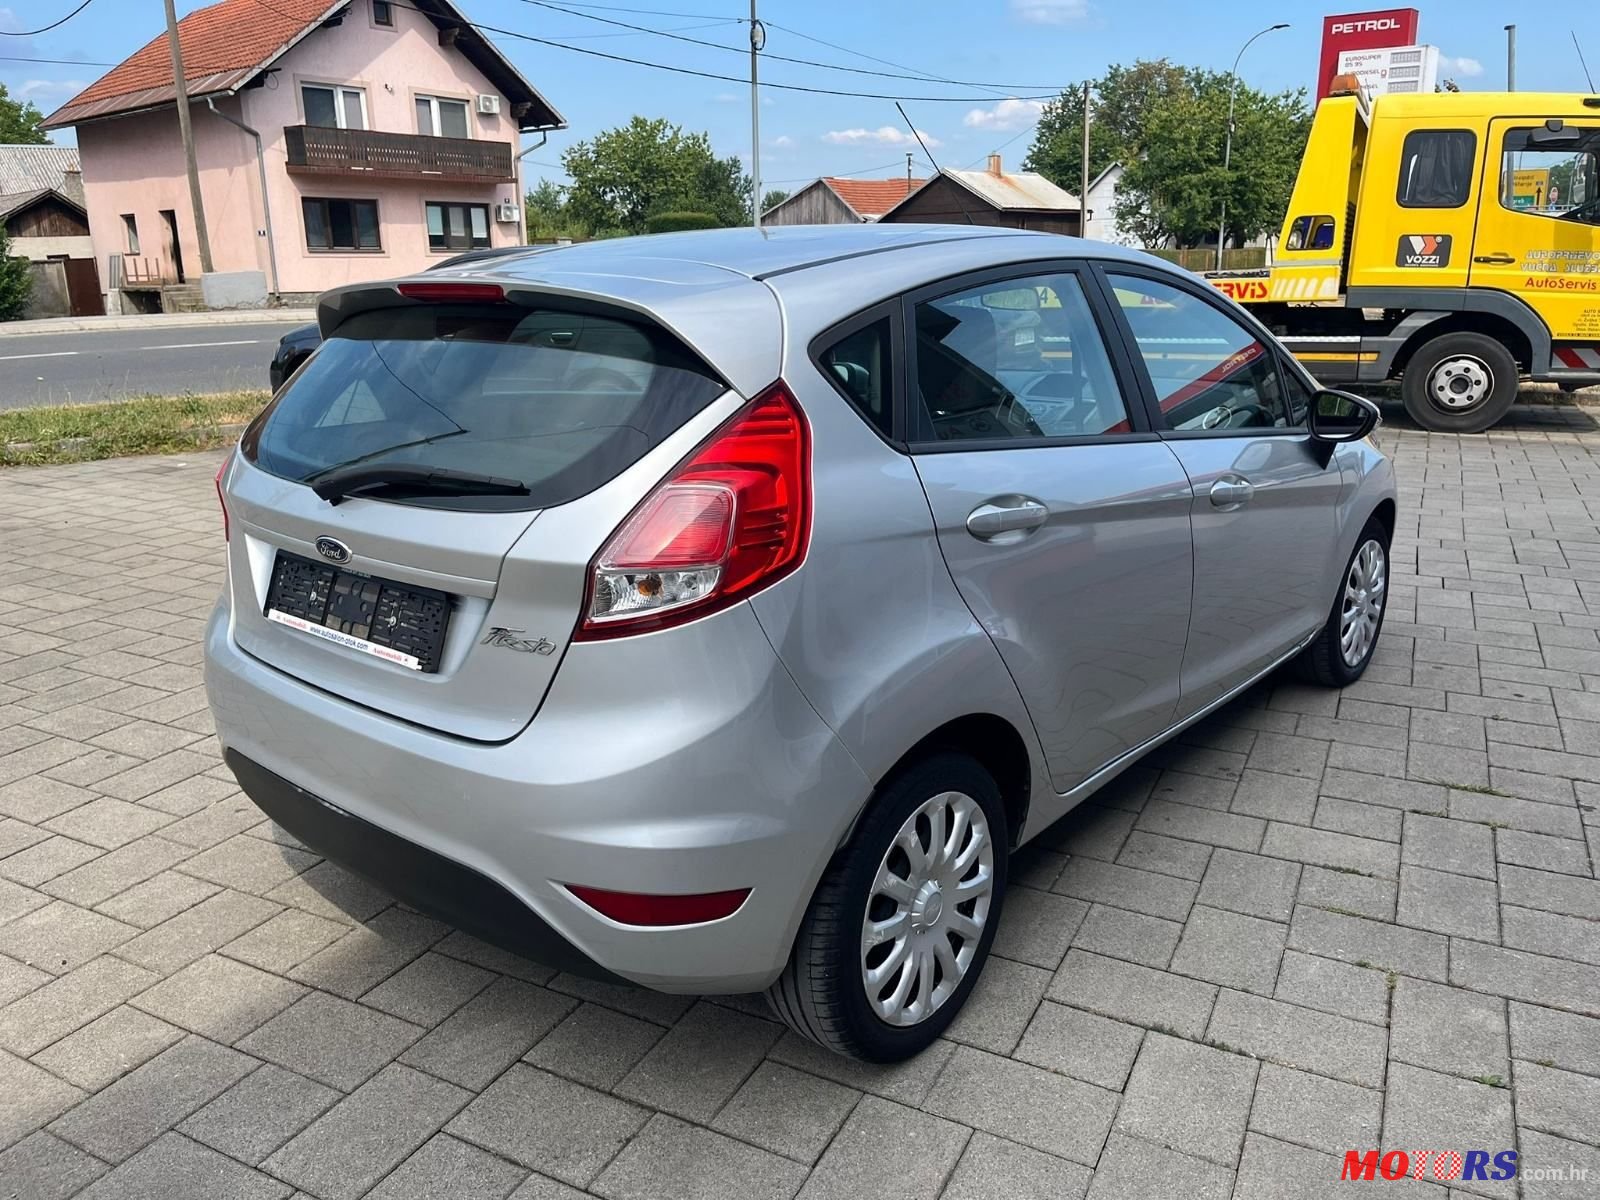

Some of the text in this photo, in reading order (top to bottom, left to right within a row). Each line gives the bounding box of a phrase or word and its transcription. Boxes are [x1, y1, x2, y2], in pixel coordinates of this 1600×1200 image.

[1331, 18, 1401, 35] PETROL
[1345, 54, 1382, 62] EUROSUPER
[1525, 277, 1597, 290] AutoServis
[310, 626, 369, 650] www.autosalon-otok.com
[480, 626, 557, 656] Fiesta
